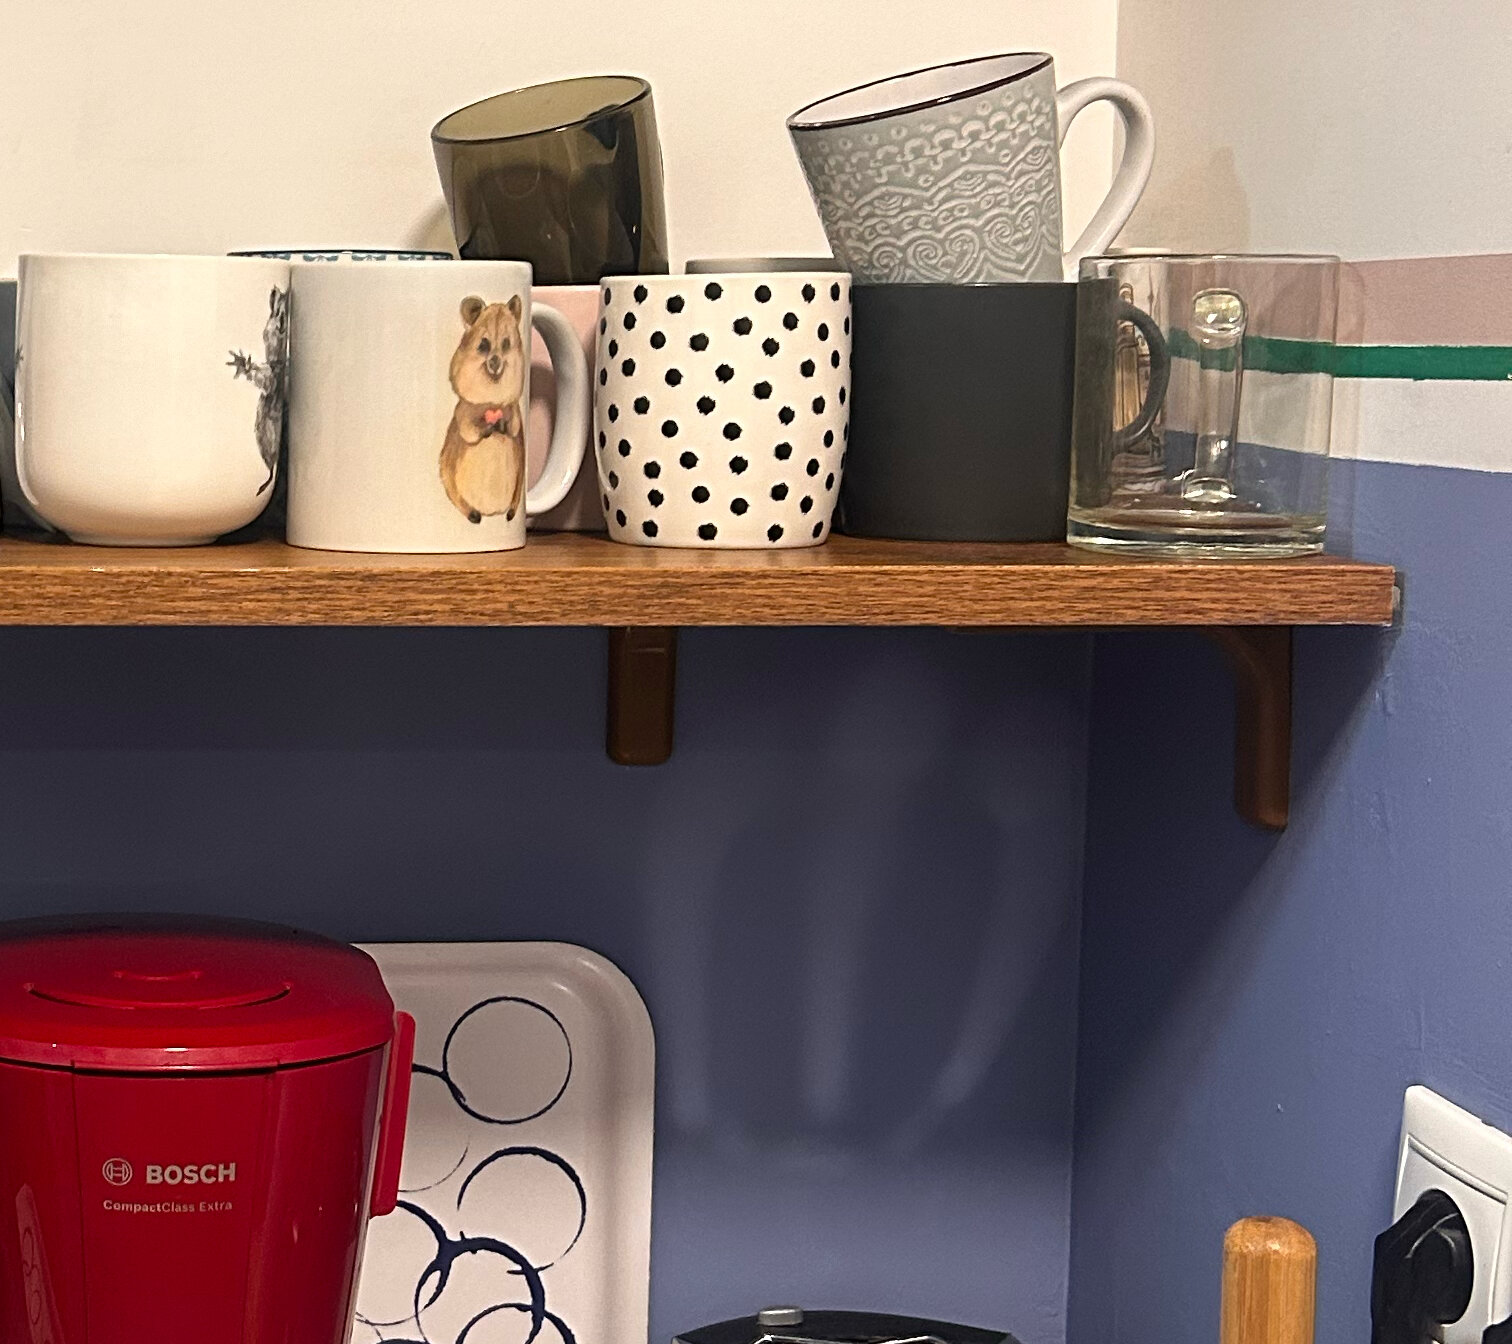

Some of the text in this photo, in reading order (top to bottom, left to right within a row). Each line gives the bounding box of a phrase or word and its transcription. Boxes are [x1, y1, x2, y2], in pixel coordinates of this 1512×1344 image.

[145, 1162, 236, 1185] BOSCH
[102, 1199, 233, 1214] CompactClass Extra
